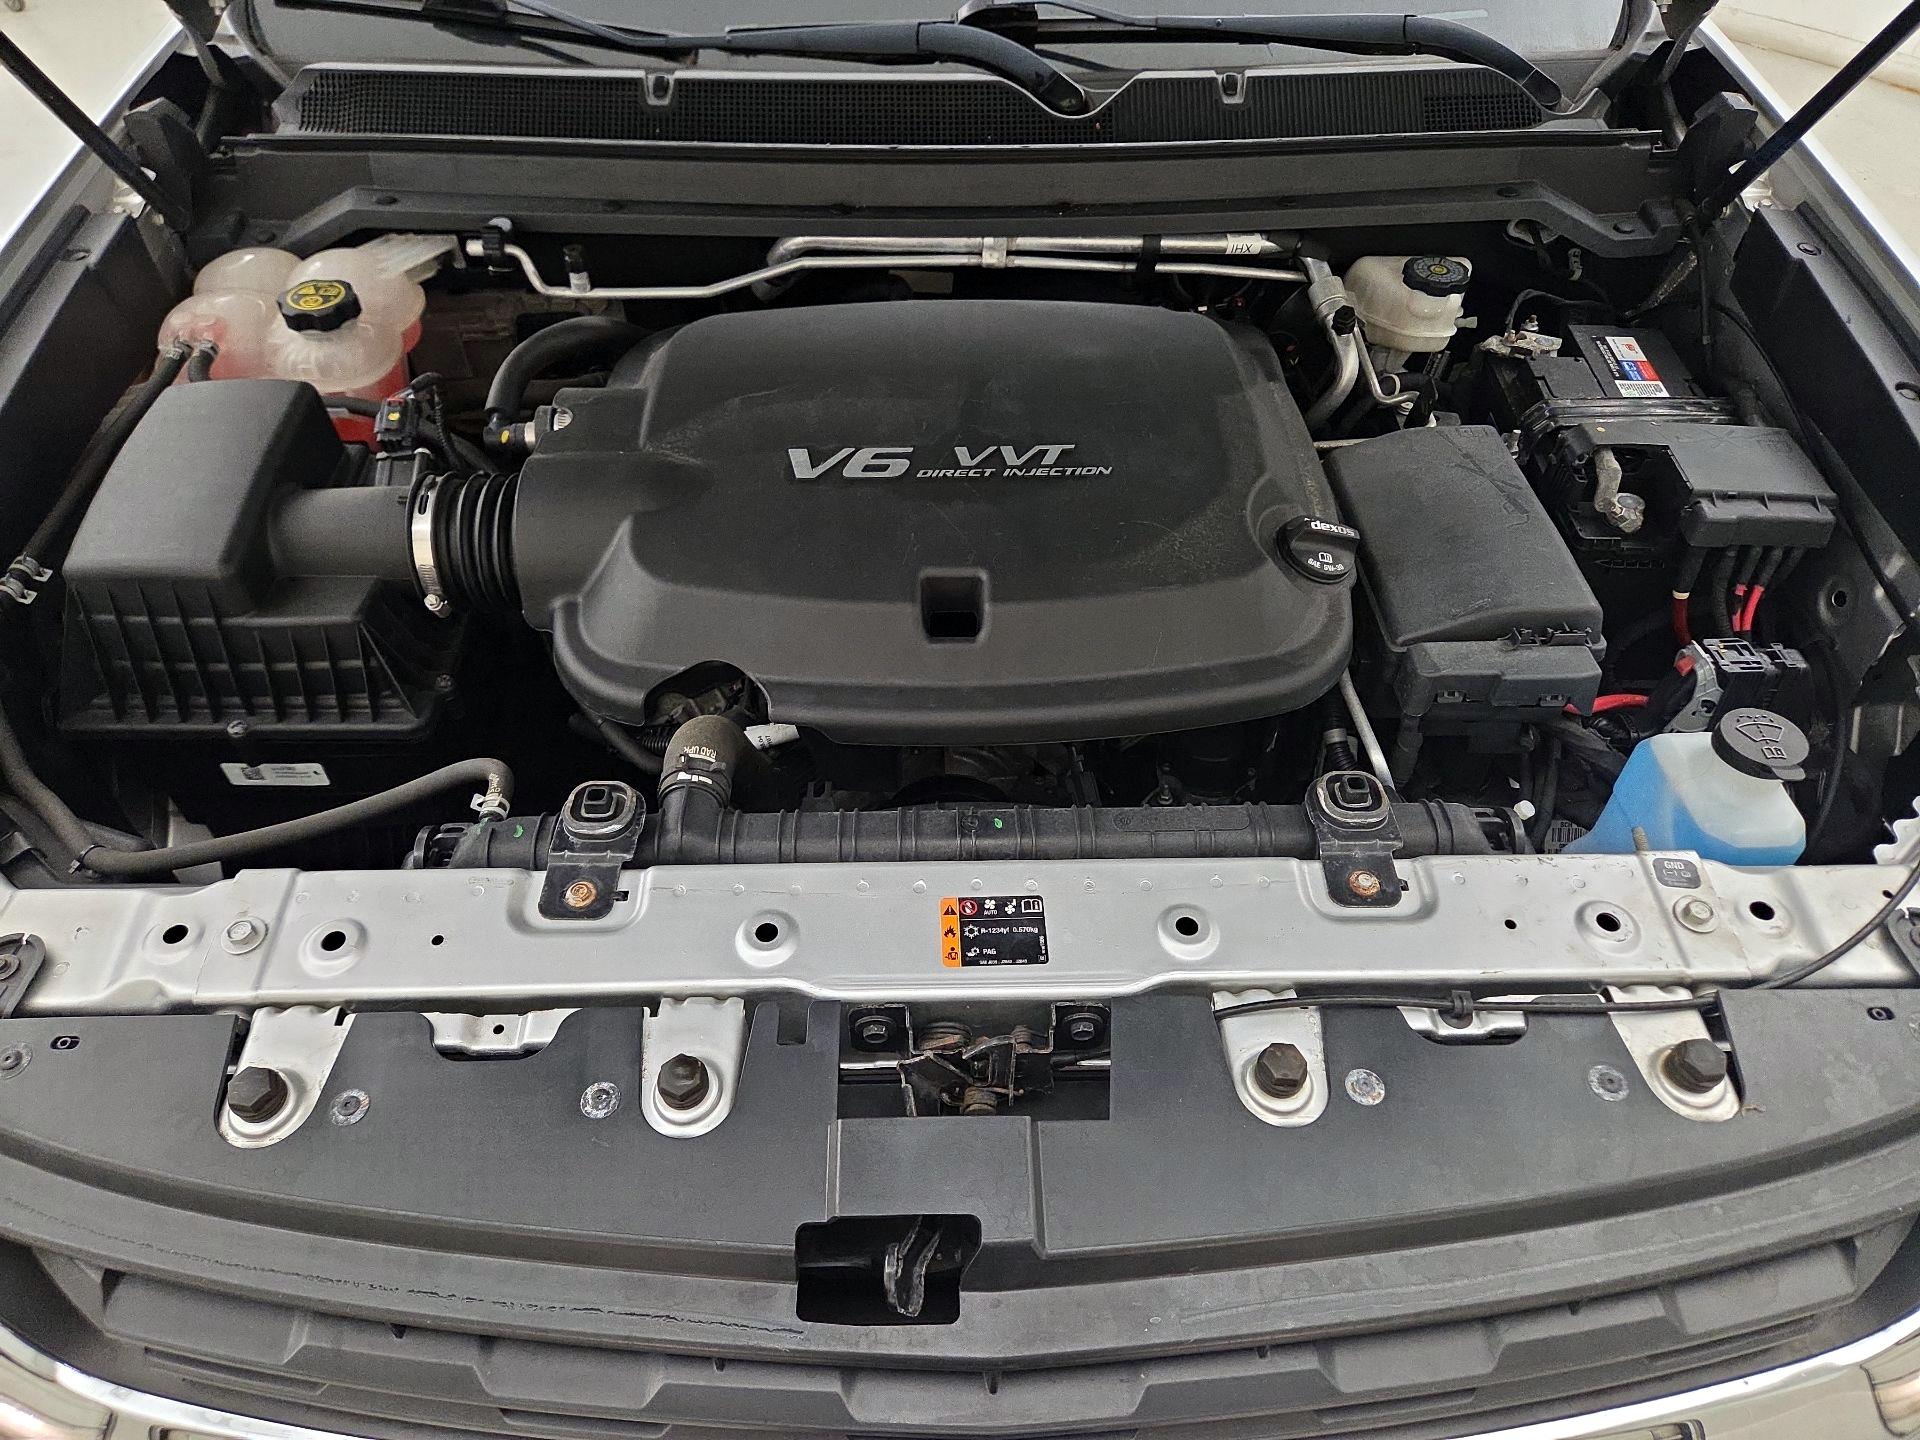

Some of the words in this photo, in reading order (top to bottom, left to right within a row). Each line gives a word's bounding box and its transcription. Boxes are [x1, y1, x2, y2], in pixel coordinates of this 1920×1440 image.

[1231, 244, 1253, 253] IHX
[788, 447, 914, 479] V6
[954, 444, 1075, 467] VVT
[916, 468, 997, 478] DIRECT
[1002, 466, 1113, 477] INJECTION
[1311, 520, 1355, 537] dexos
[1307, 558, 1321, 568] SAE
[701, 746, 717, 760] RAD
[1664, 860, 1685, 870] GND
